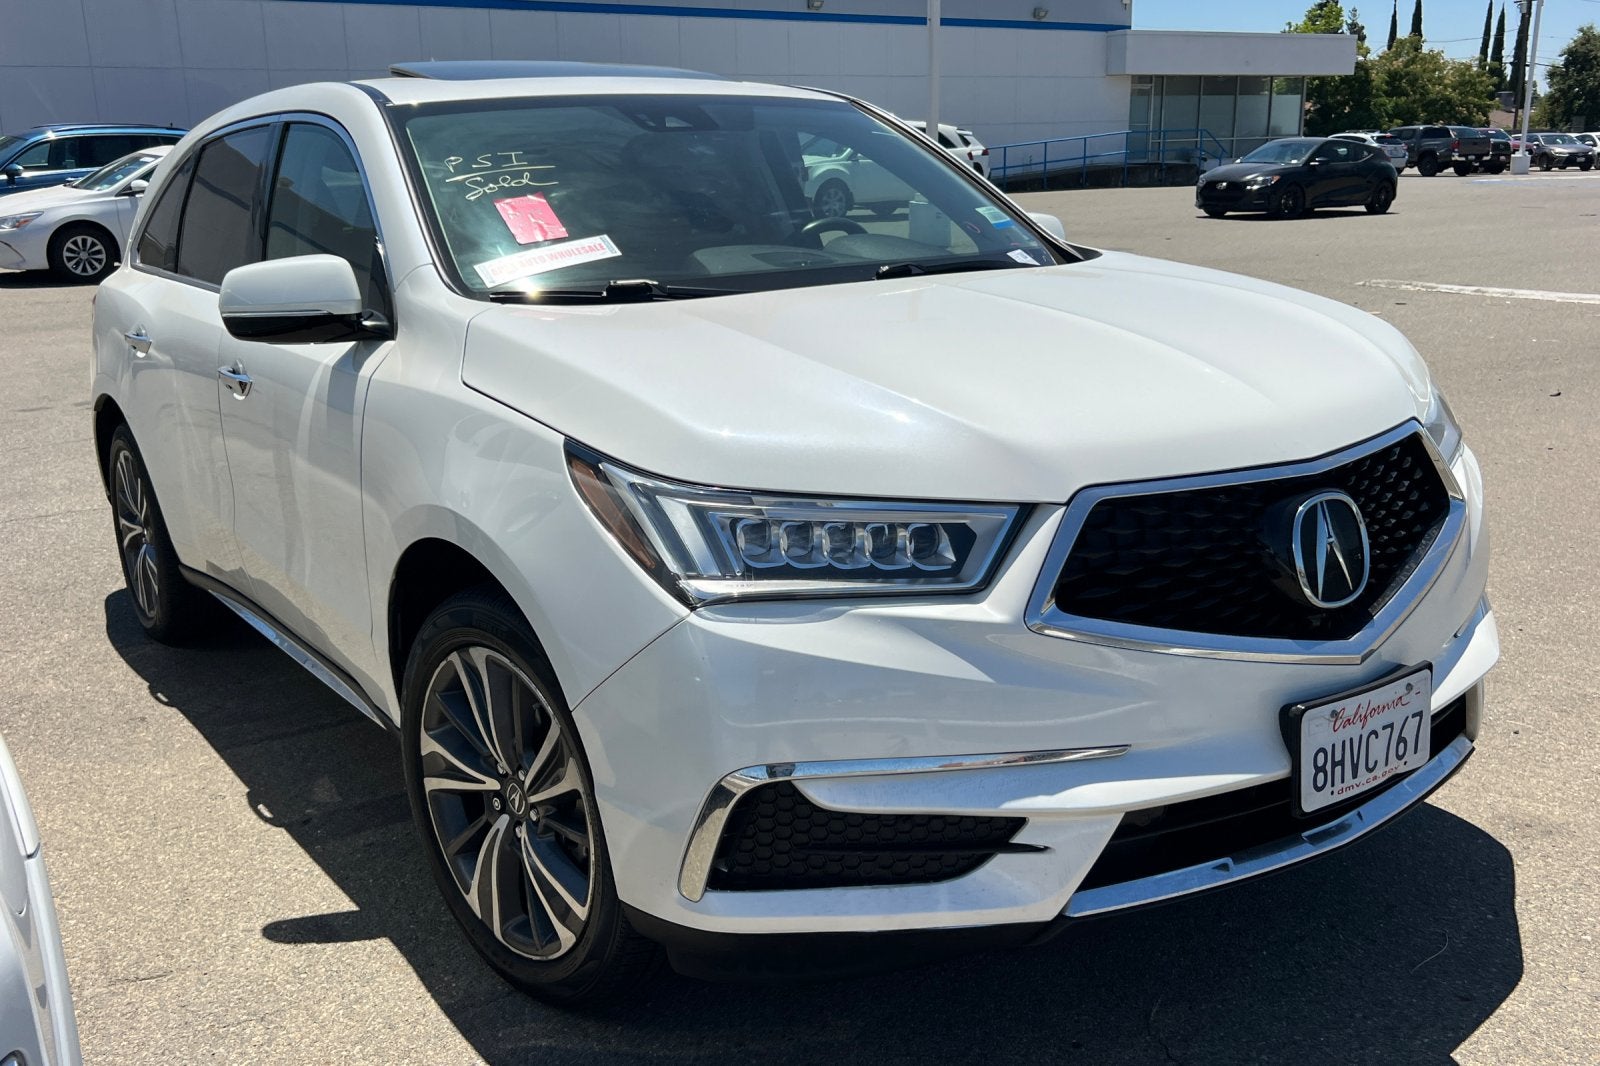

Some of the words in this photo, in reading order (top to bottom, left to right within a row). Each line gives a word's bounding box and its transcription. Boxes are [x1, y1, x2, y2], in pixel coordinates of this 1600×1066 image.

[546, 242, 606, 262] WHOLESALE
[1332, 693, 1410, 732] California
[1312, 710, 1424, 793] 8HVC767
[1337, 764, 1400, 796] dmv.ca.gov
